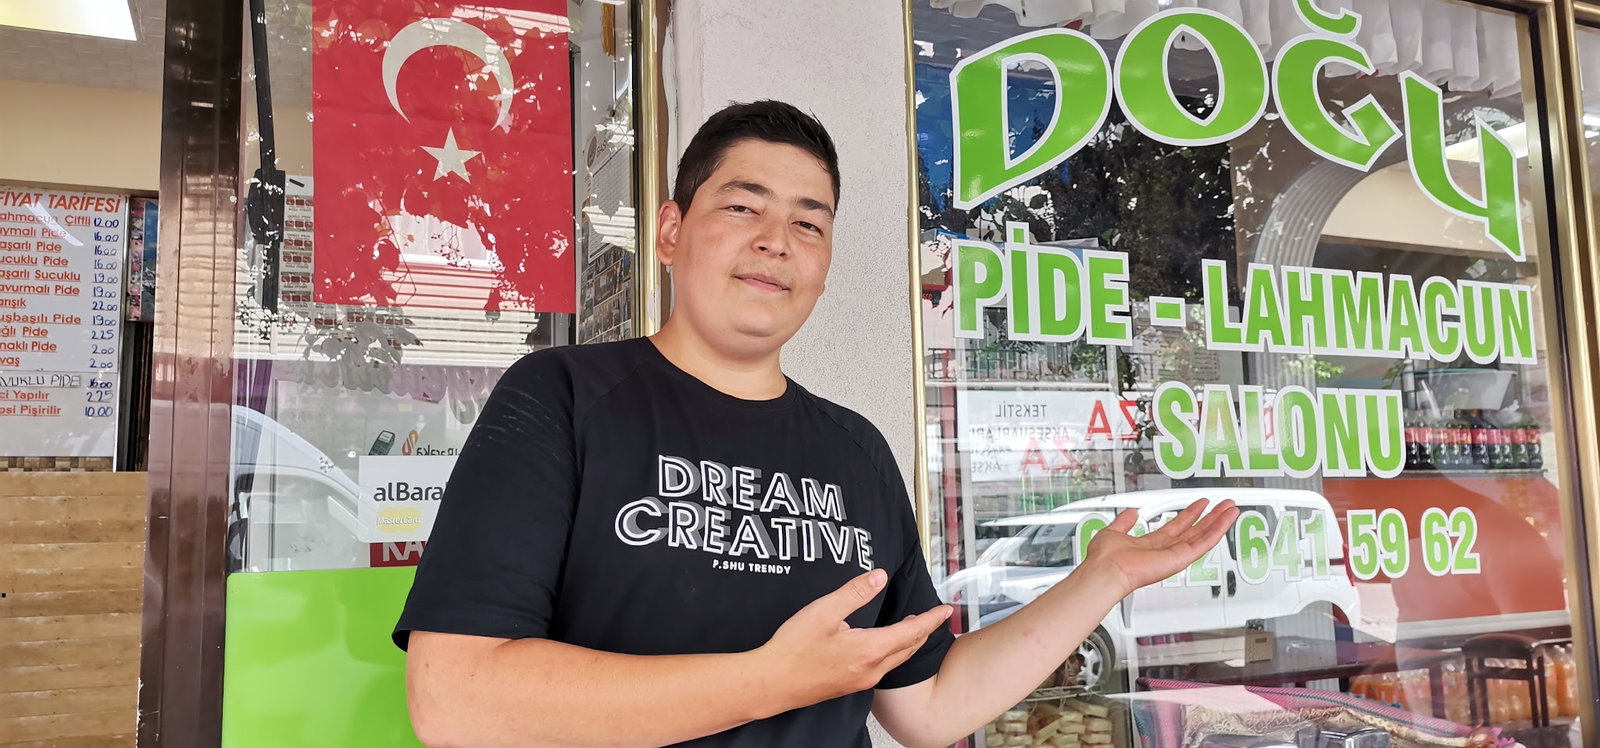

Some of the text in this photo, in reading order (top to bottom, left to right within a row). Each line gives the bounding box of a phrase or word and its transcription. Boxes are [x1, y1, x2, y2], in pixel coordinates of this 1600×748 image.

[949, 0, 1526, 262] DOĞU
[48, 192, 121, 213] TARİFESİ
[64, 215, 91, 226] Çiftli
[37, 241, 62, 252] Pide
[43, 255, 69, 266] Pide
[35, 269, 81, 281] Sucuklu
[54, 285, 80, 296] Pide
[951, 222, 1133, 346] PİDE
[1202, 259, 1537, 365] LAHMACUN
[53, 314, 82, 324] Pide
[22, 326, 49, 337] Pide
[31, 341, 57, 352] Pide
[0, 375, 45, 387] VUKLU
[13, 390, 50, 401] Yapılır
[20, 404, 62, 416] Pişirilir
[1153, 381, 1407, 480] SALONU
[373, 482, 450, 502] alBara
[658, 454, 847, 522] DREAM
[615, 496, 875, 571] CREATIVE
[1235, 509, 1331, 584] 641
[1347, 507, 1410, 581] 59
[1421, 505, 1481, 577] 62
[712, 559, 791, 575] P.SHU TRENDY
